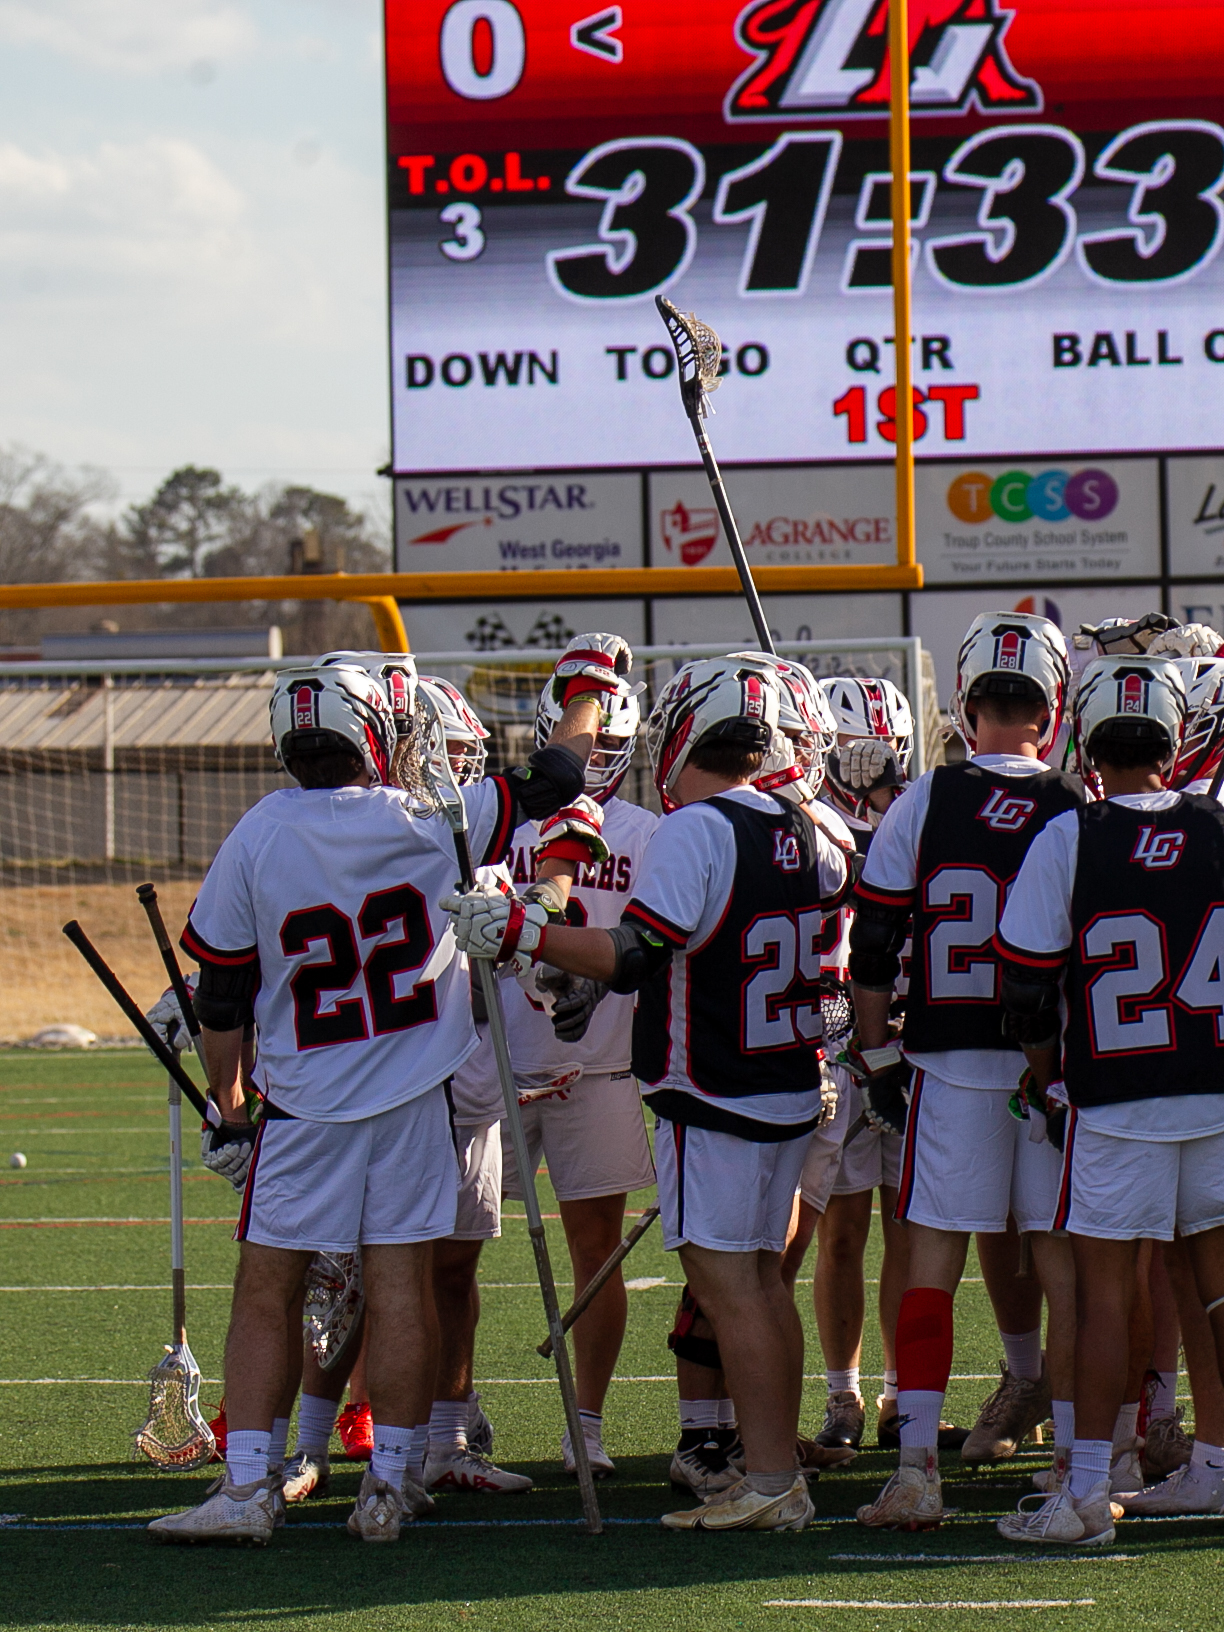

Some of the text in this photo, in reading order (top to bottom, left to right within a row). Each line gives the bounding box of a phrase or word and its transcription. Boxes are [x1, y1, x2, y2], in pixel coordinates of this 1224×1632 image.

[440, 0, 526, 100] 0
[397, 152, 551, 195] T.O.L.
[440, 202, 486, 261] 3
[1052, 333, 1183, 368] BALL
[404, 349, 560, 389] DOWN
[500, 537, 621, 562] West Georgia
[944, 528, 1129, 550] Troup County School System
[986, 559, 1031, 571] Future
[1035, 558, 1076, 570] Starts
[1080, 556, 1122, 570] Today
[1000, 655, 1016, 668] 28
[297, 711, 312, 725] 22
[747, 700, 761, 715] 25
[1126, 699, 1140, 713] 24
[278, 880, 439, 1053] 22
